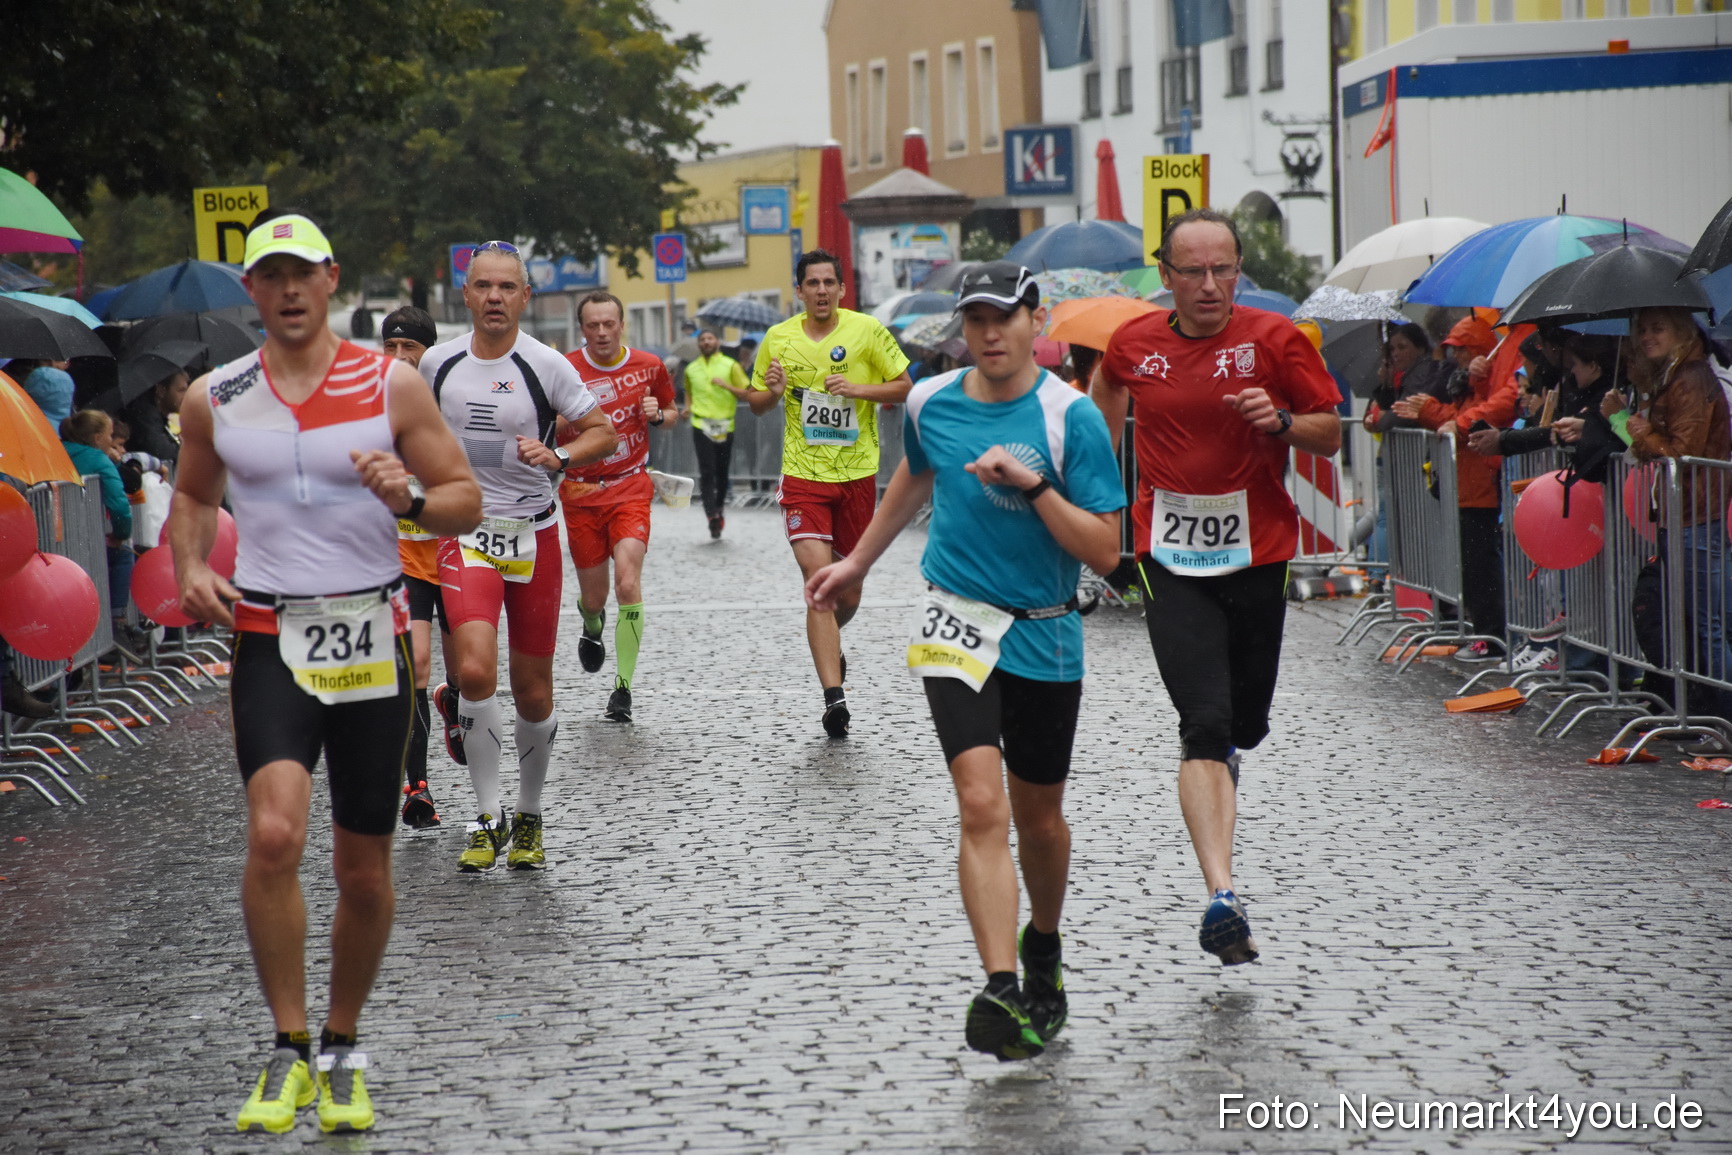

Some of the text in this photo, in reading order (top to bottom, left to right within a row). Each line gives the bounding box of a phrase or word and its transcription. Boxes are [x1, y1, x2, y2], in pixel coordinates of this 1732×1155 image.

[1151, 159, 1203, 179] Block
[203, 191, 260, 212] Block
[216, 221, 248, 265] D
[657, 266, 684, 279] TAXI
[806, 405, 851, 428] 2897
[812, 429, 848, 440] Christian
[398, 520, 422, 534] Georg
[1163, 512, 1240, 547] 2792
[475, 531, 519, 558] 351
[1172, 553, 1230, 567] Bernhard
[922, 607, 982, 650] 355
[305, 620, 374, 662] 234
[920, 649, 965, 666] Thomas
[309, 671, 372, 689] Thorsten
